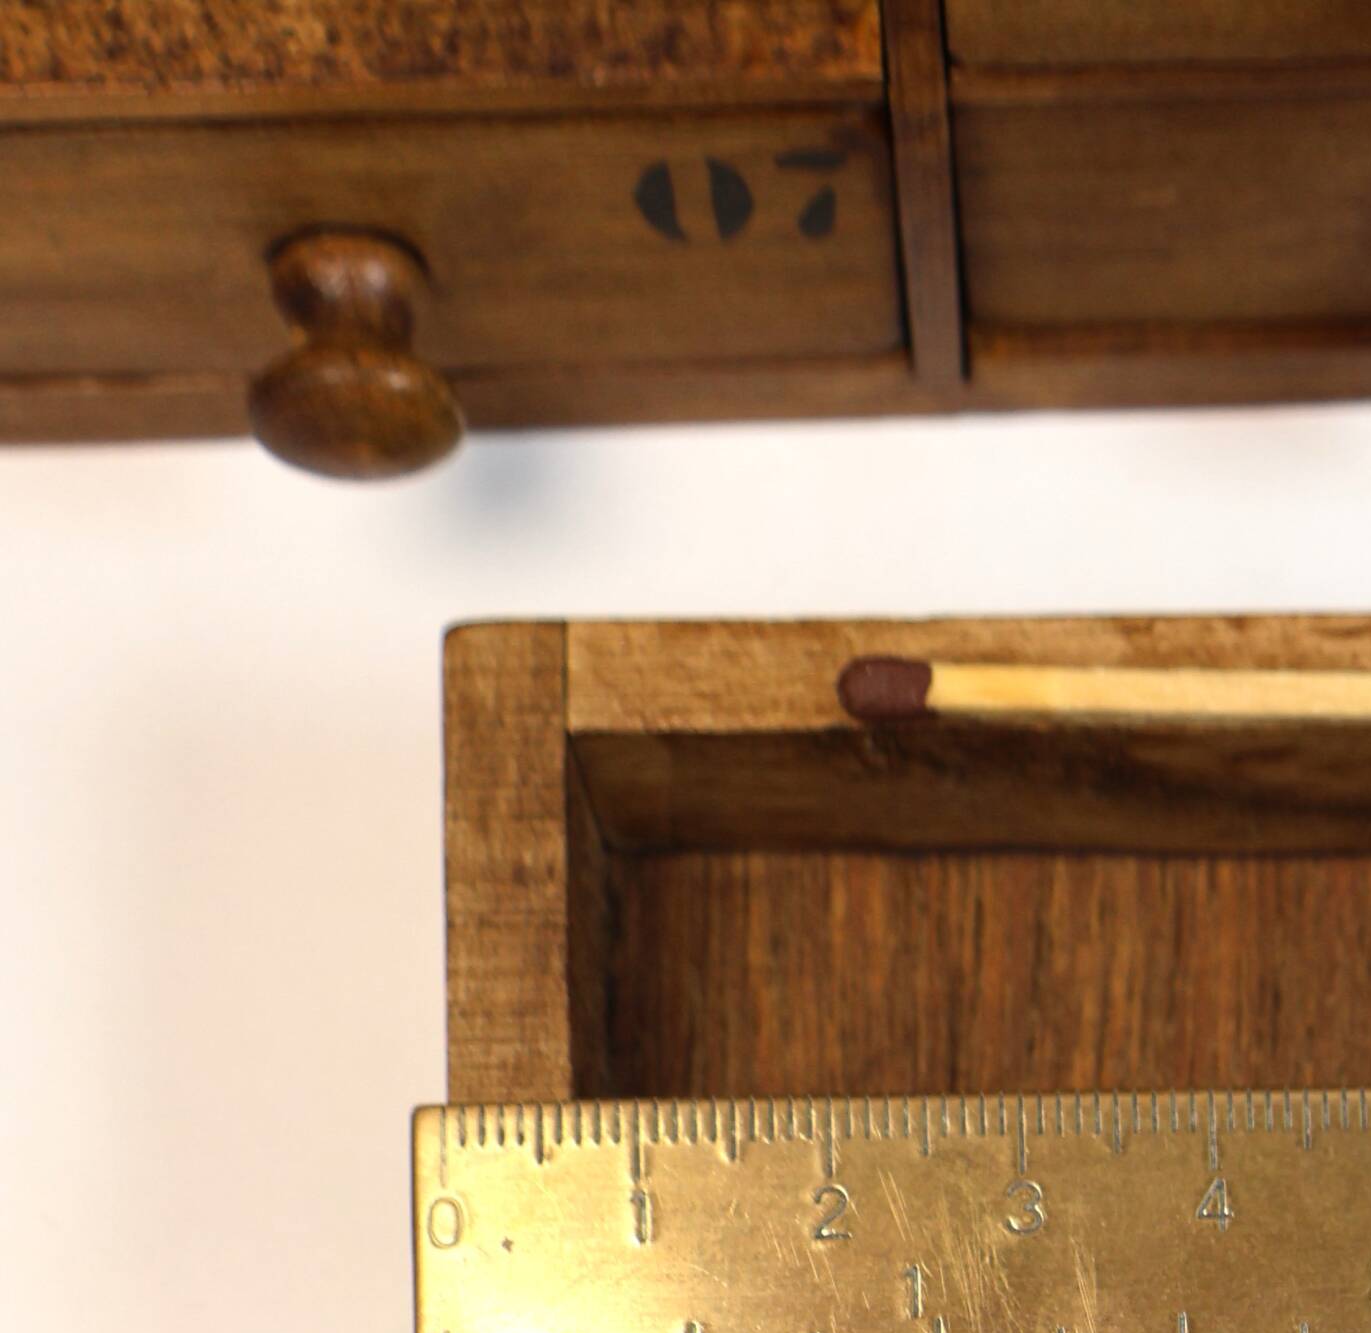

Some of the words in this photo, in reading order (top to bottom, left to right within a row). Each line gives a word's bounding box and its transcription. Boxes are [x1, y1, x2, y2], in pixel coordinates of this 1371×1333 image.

[632, 149, 849, 243] 07
[428, 1198, 462, 1248] 0
[631, 1188, 653, 1245] 1
[813, 1184, 853, 1240] 2
[1005, 1180, 1046, 1235] 3
[1195, 1177, 1234, 1232] 4
[905, 1263, 923, 1319] 1
